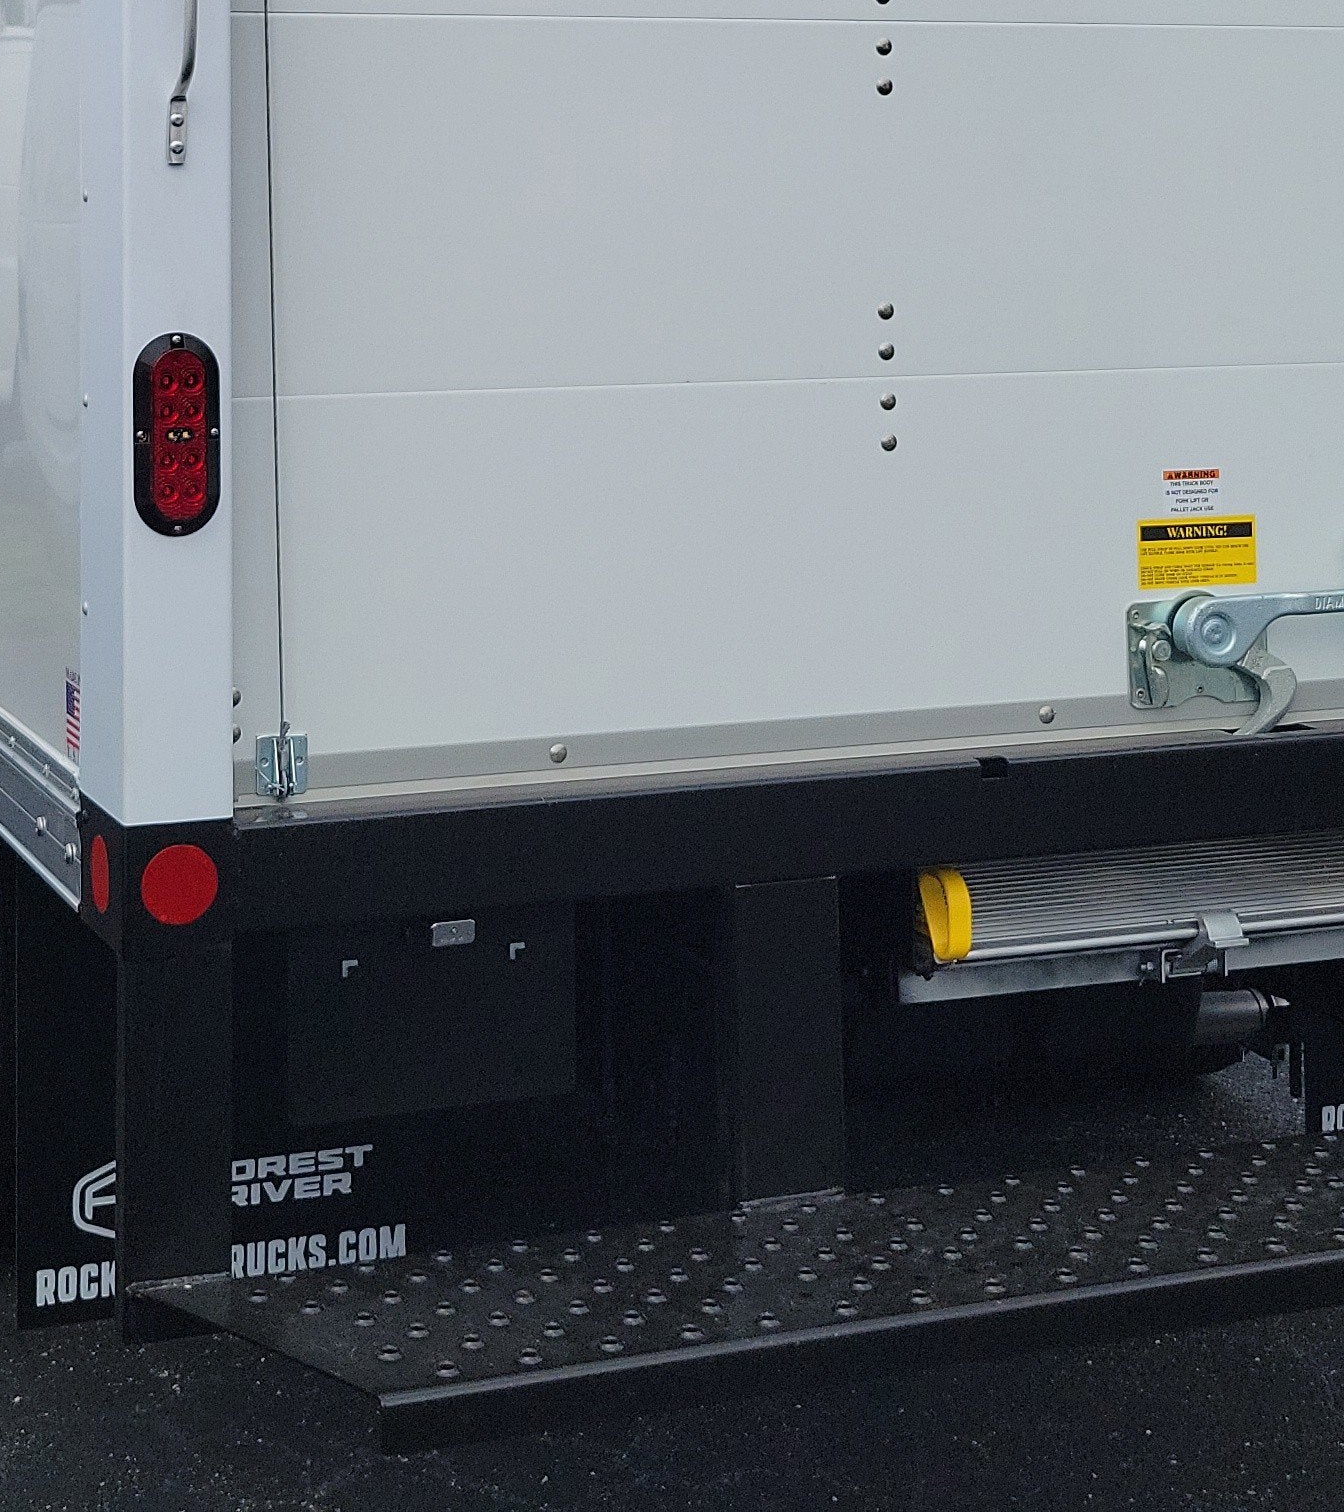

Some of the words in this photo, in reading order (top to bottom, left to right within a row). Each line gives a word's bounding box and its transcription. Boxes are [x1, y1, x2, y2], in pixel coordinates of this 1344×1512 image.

[1175, 470, 1216, 480] WARNING
[1166, 525, 1227, 538] WARNING!
[231, 1144, 373, 1182] OREST
